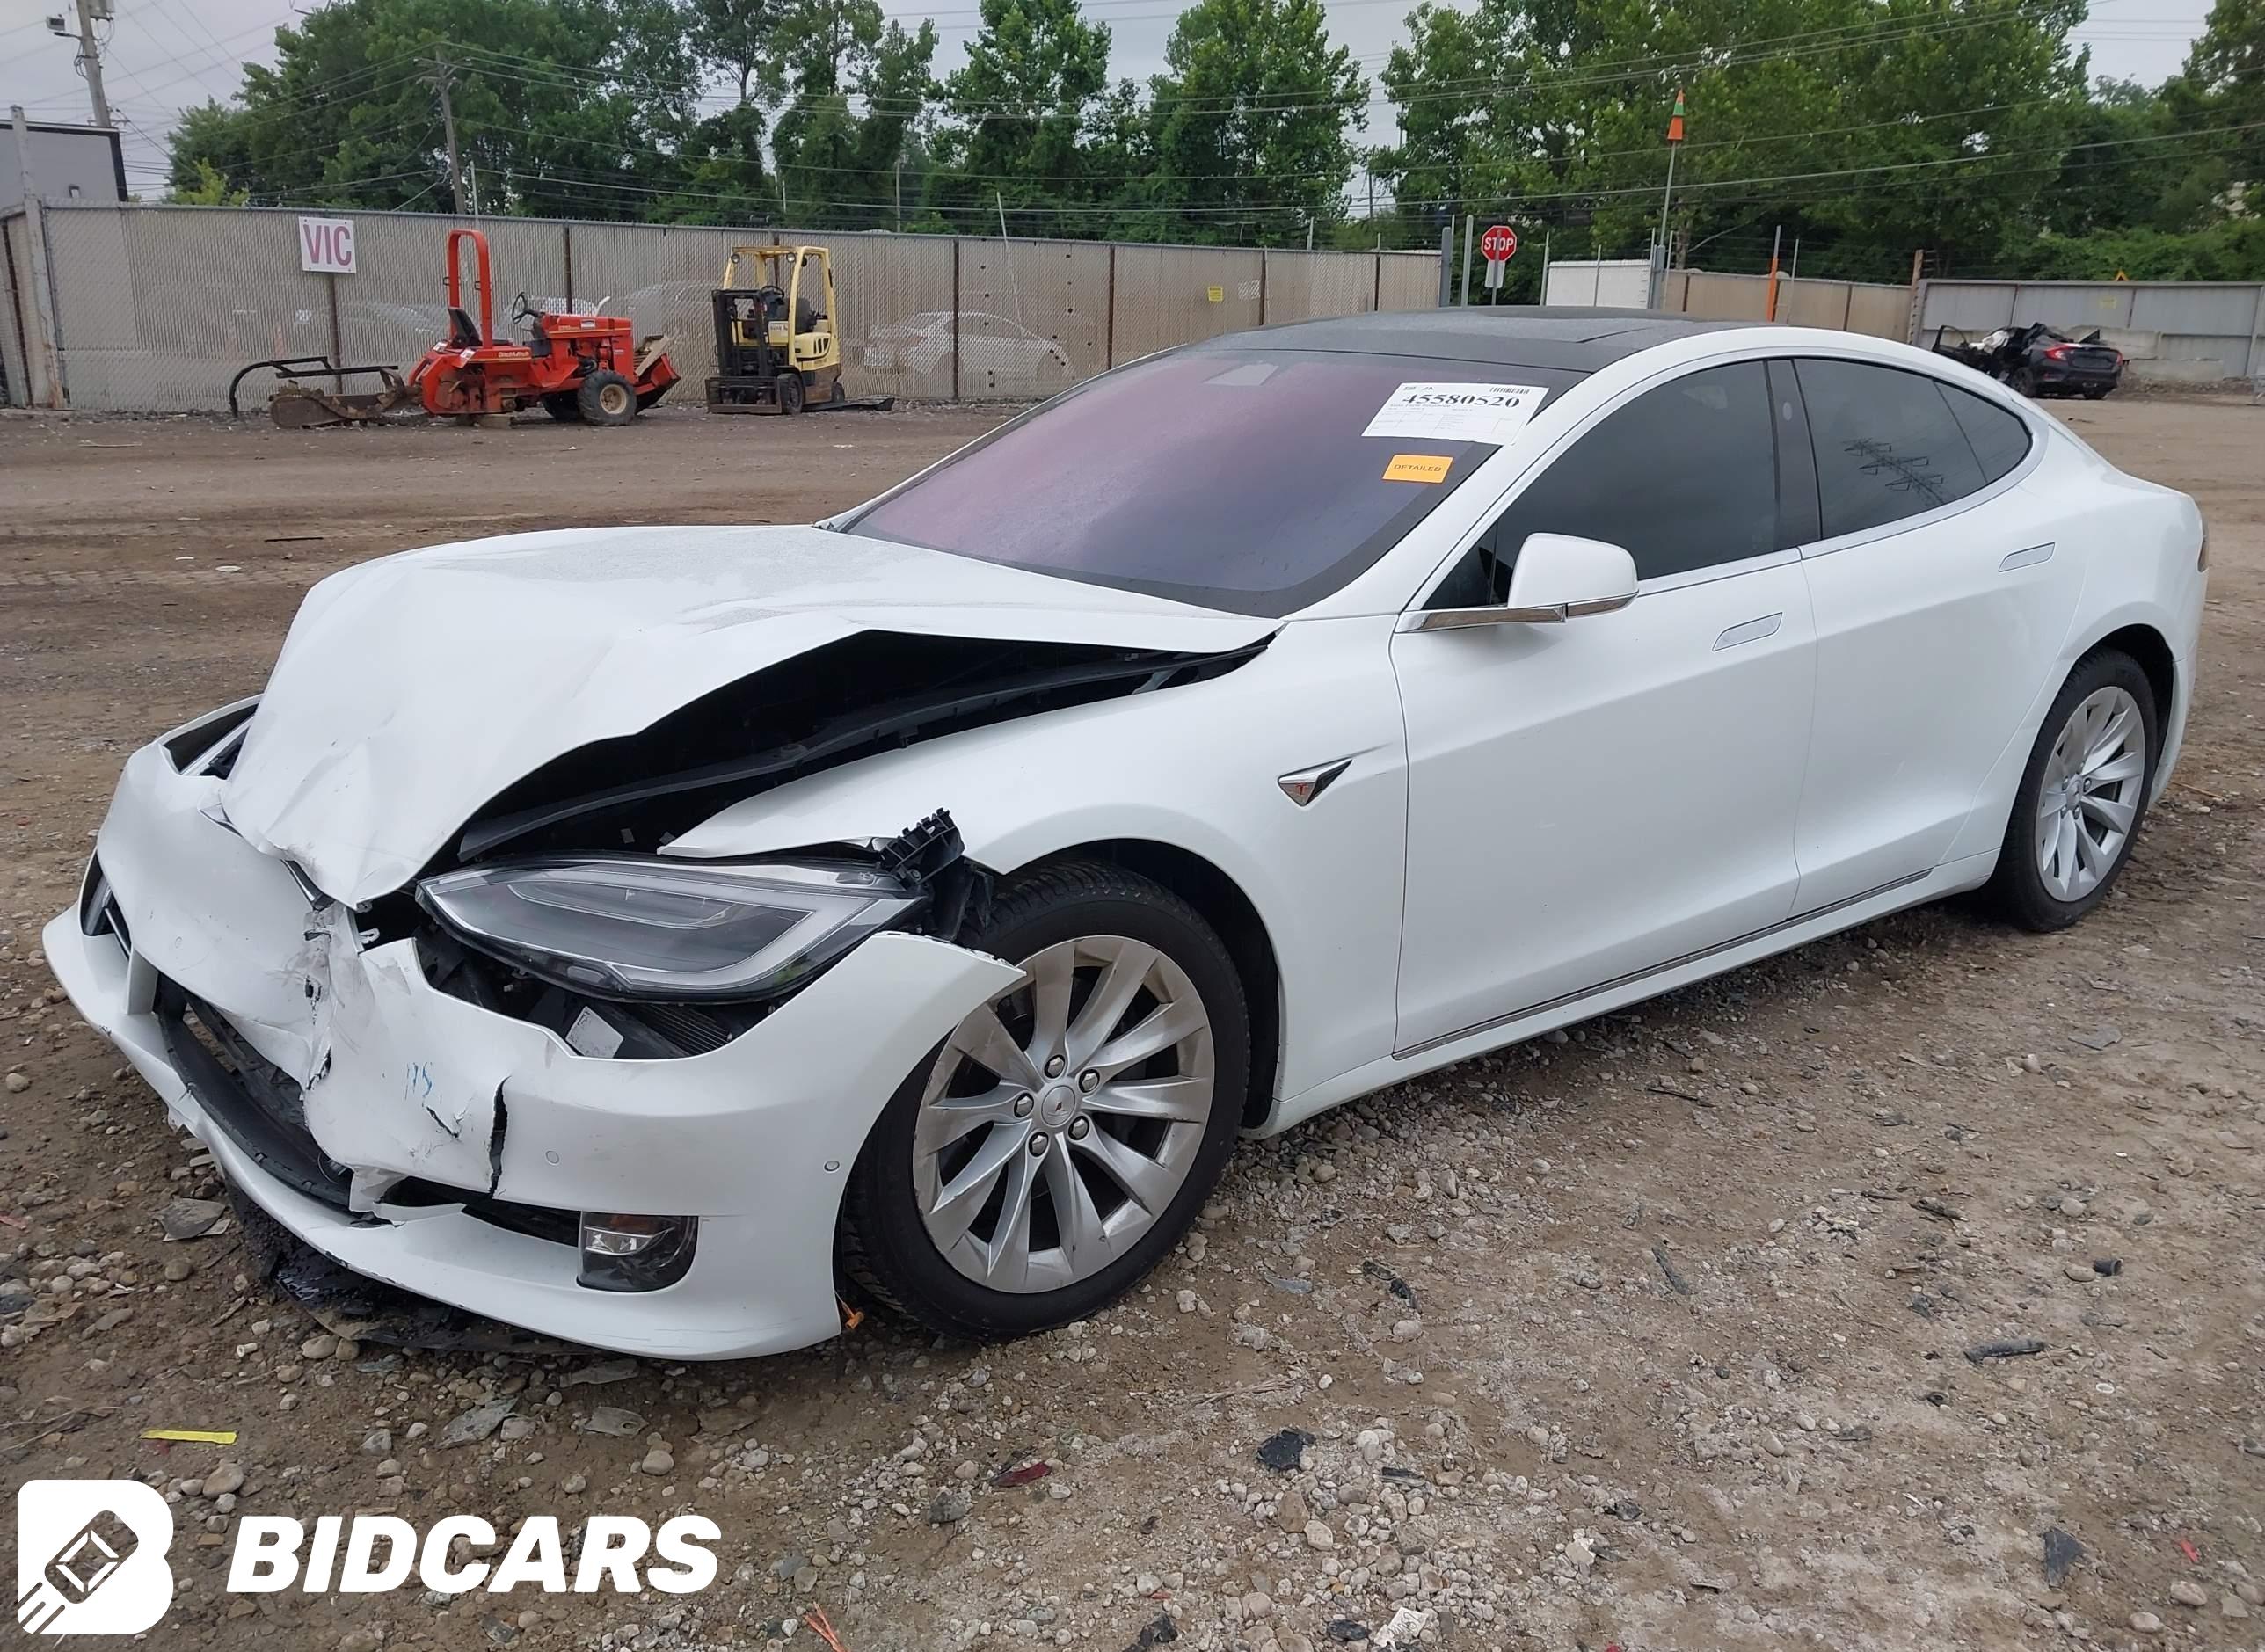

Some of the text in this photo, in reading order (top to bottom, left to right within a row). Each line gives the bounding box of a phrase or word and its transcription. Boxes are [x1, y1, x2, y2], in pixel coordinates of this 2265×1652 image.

[303, 224, 352, 266] VIC
[1483, 236, 1514, 251] STOP
[1402, 393, 1520, 408] 45580520
